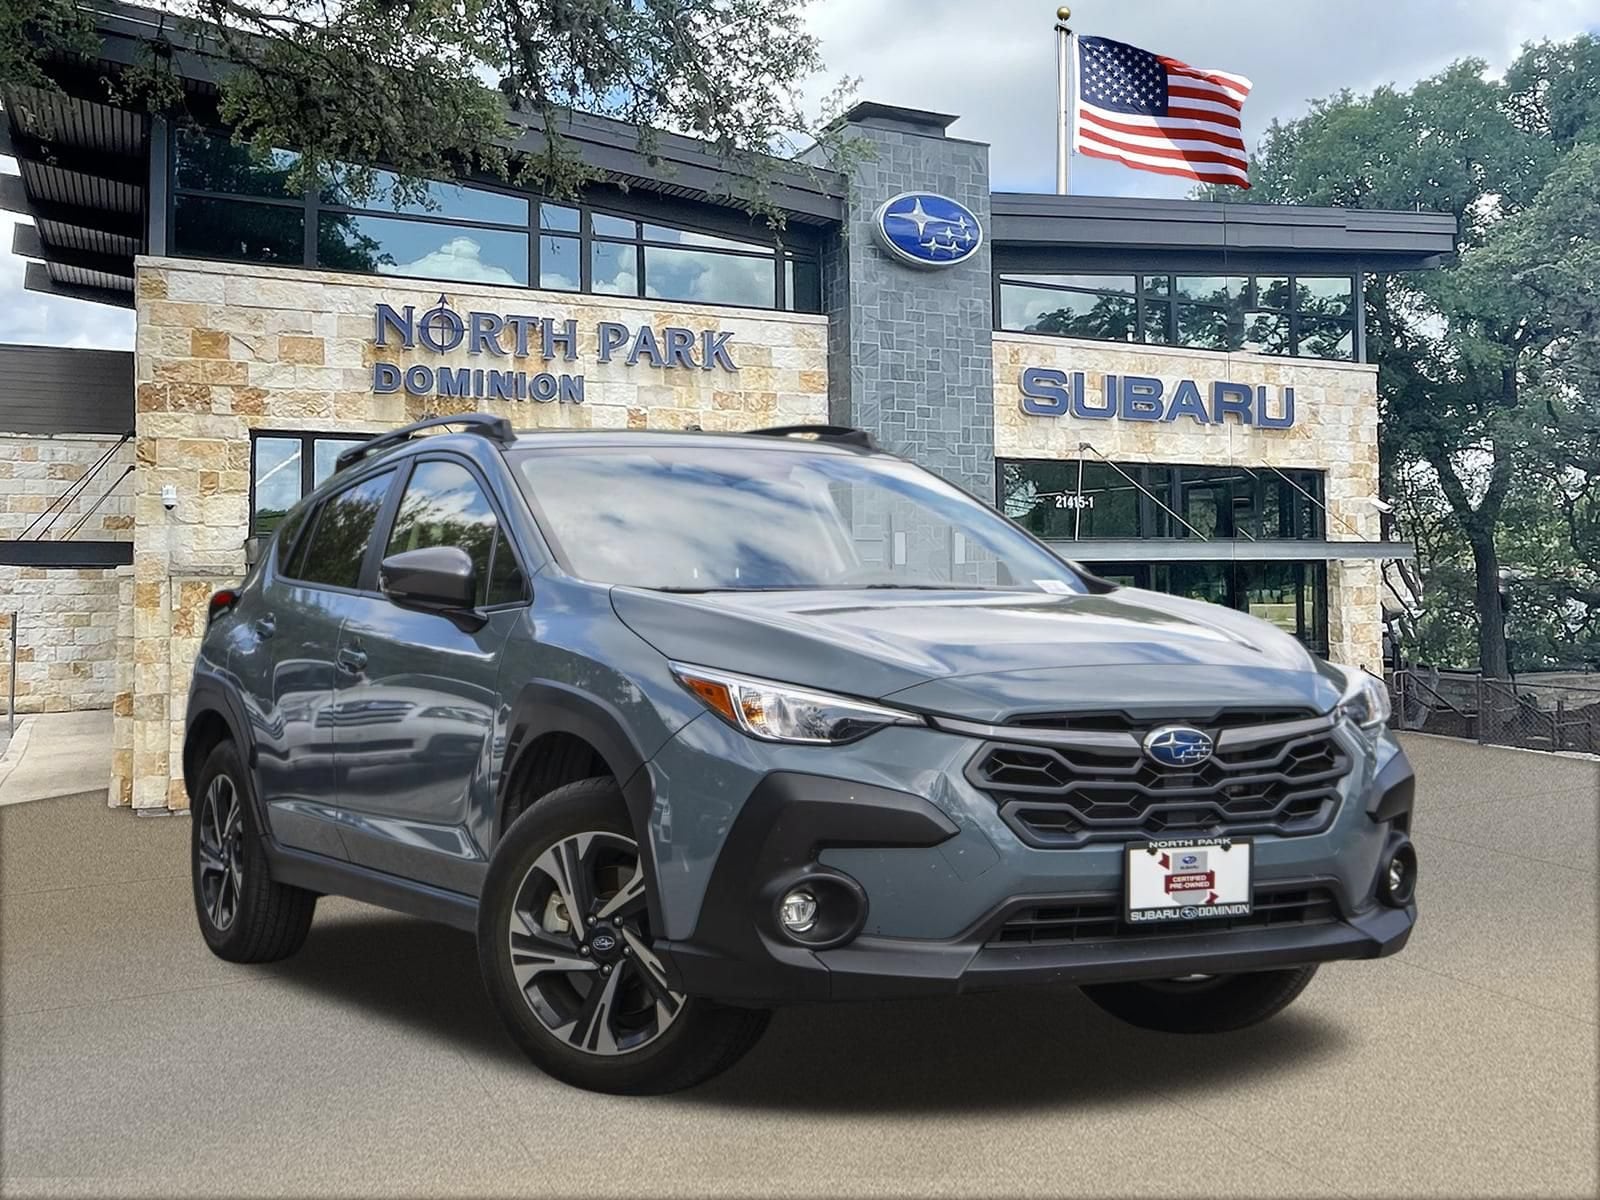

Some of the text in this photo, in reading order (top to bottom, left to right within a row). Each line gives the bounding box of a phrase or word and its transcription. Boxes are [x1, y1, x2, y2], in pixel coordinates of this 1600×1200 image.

[374, 302, 742, 374] NORTH PARK
[373, 362, 586, 405] DOMINION
[1018, 367, 1296, 430] SUBARU
[1149, 838, 1232, 848] NORTH PARK
[1169, 881, 1210, 889] PRE-OWNED
[1130, 904, 1250, 921] SUBARU DOMINION
